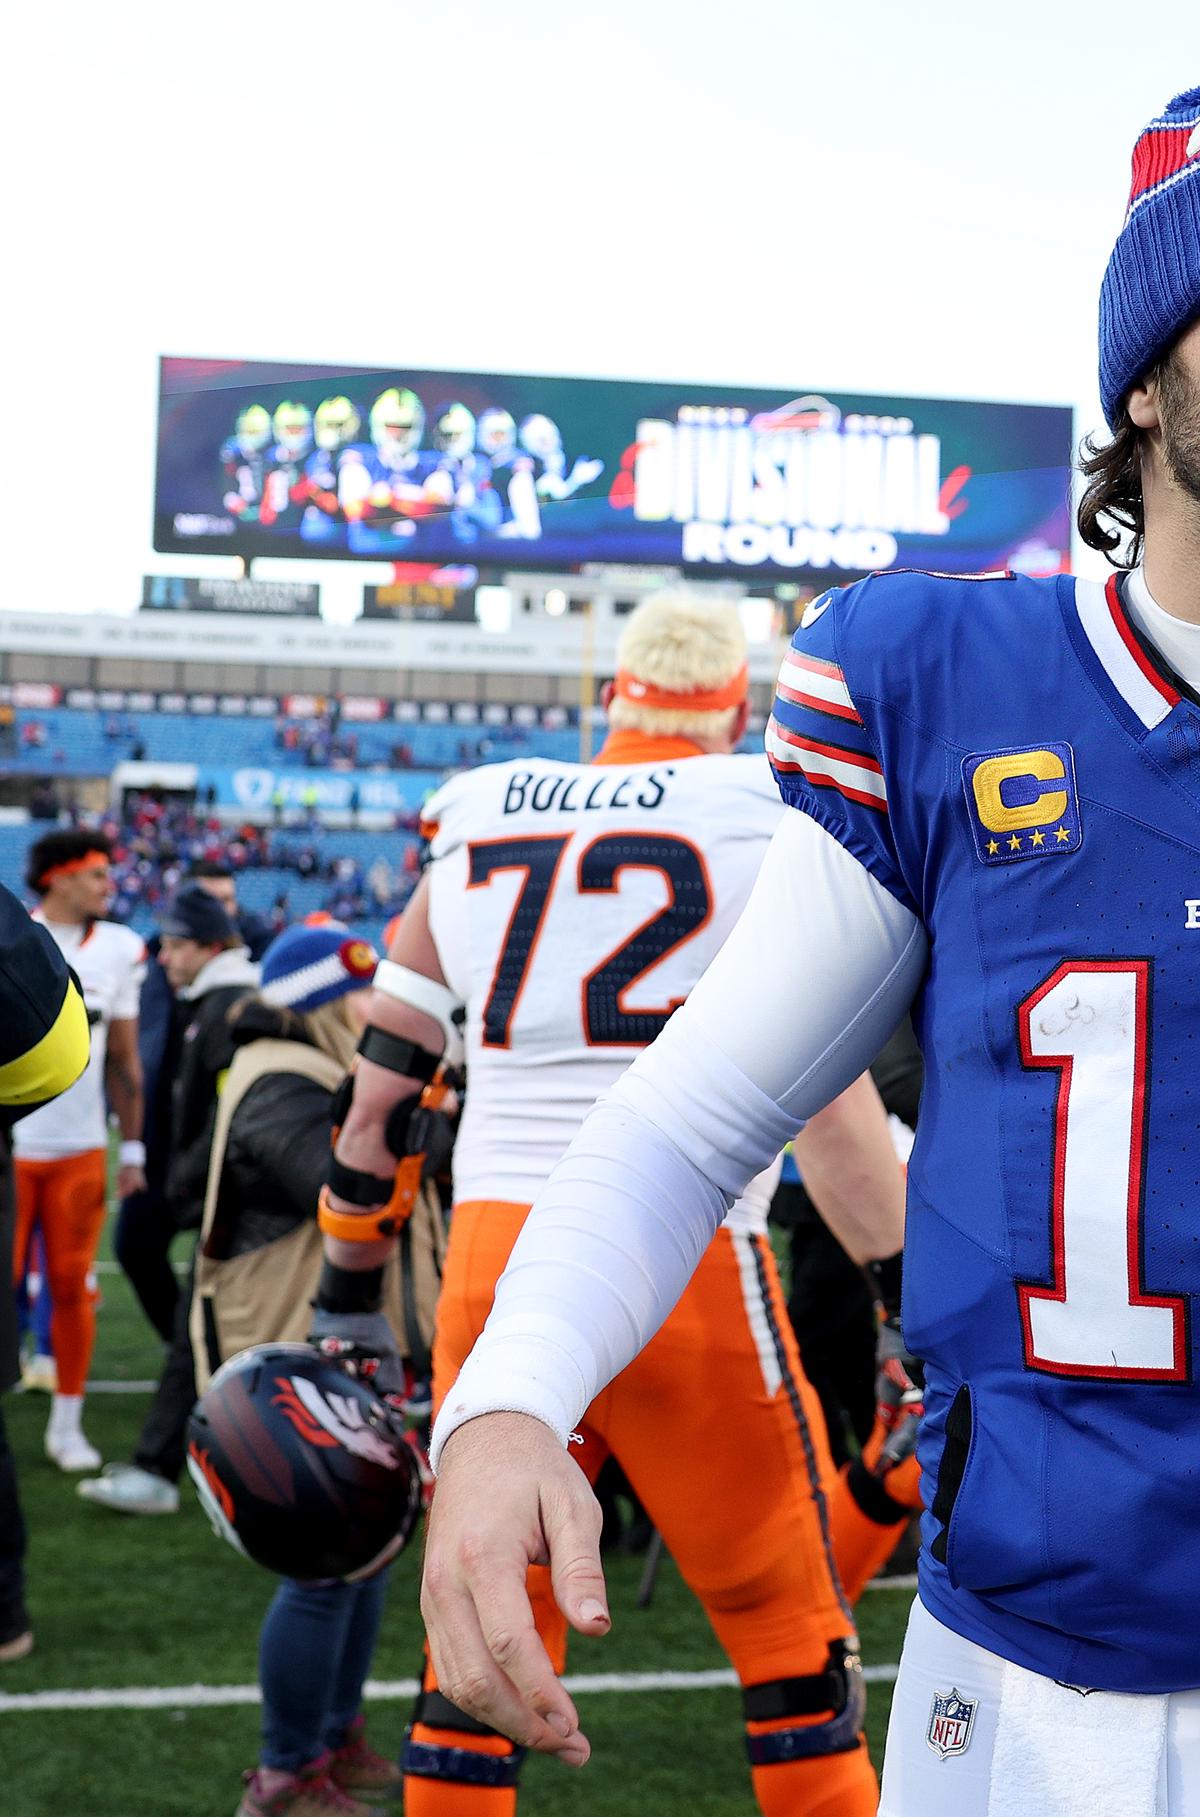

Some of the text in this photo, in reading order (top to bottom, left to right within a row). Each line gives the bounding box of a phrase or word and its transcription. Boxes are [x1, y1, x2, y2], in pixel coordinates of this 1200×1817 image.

[634, 418, 950, 535] DIVISIONAL
[682, 520, 898, 569] ROUND
[504, 768, 676, 815] BOLLES
[973, 750, 1068, 833] C
[466, 831, 716, 1050] 72
[932, 1719, 963, 1748] NFL
